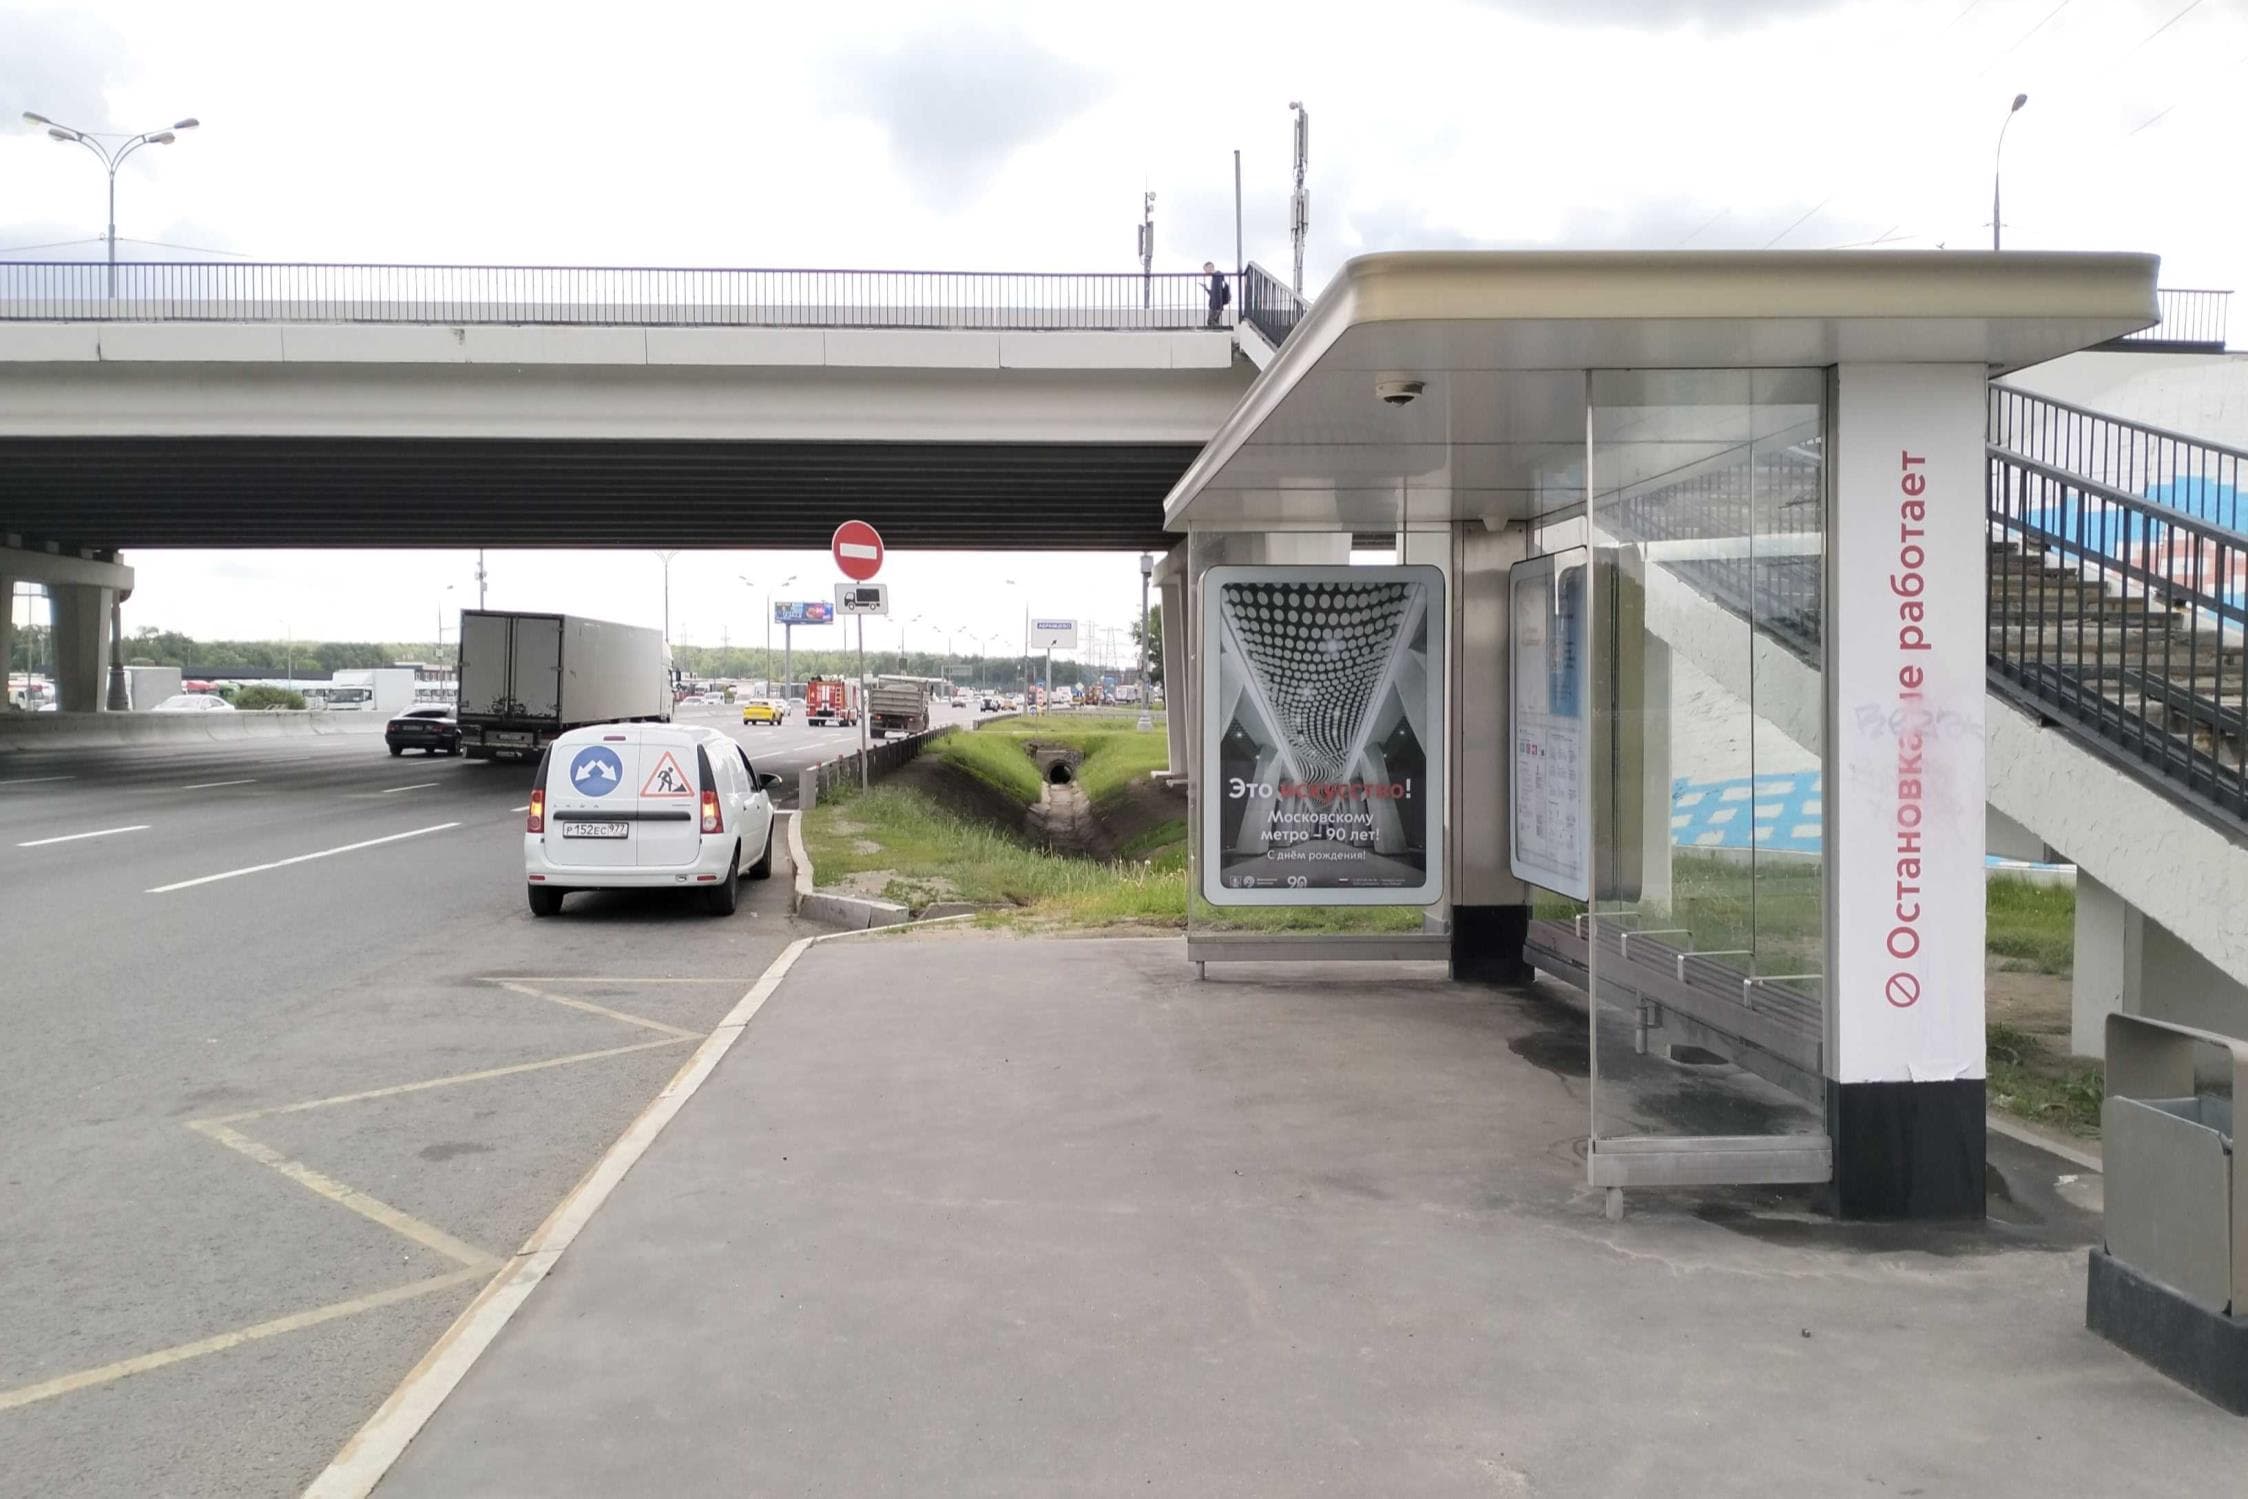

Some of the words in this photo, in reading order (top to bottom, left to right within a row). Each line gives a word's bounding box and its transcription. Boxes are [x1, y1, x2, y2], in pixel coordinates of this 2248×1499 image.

[1888, 449, 1932, 650] работает
[1229, 777, 1273, 799] Это
[1279, 778, 1412, 803] искусство!
[1267, 811, 1374, 827] Московскому
[1260, 830, 1309, 843] метро
[1326, 827, 1346, 841] 90
[1349, 827, 1380, 841] лет!
[1267, 849, 1275, 860] С
[1277, 849, 1306, 861] днём
[1308, 849, 1366, 863] рождения!
